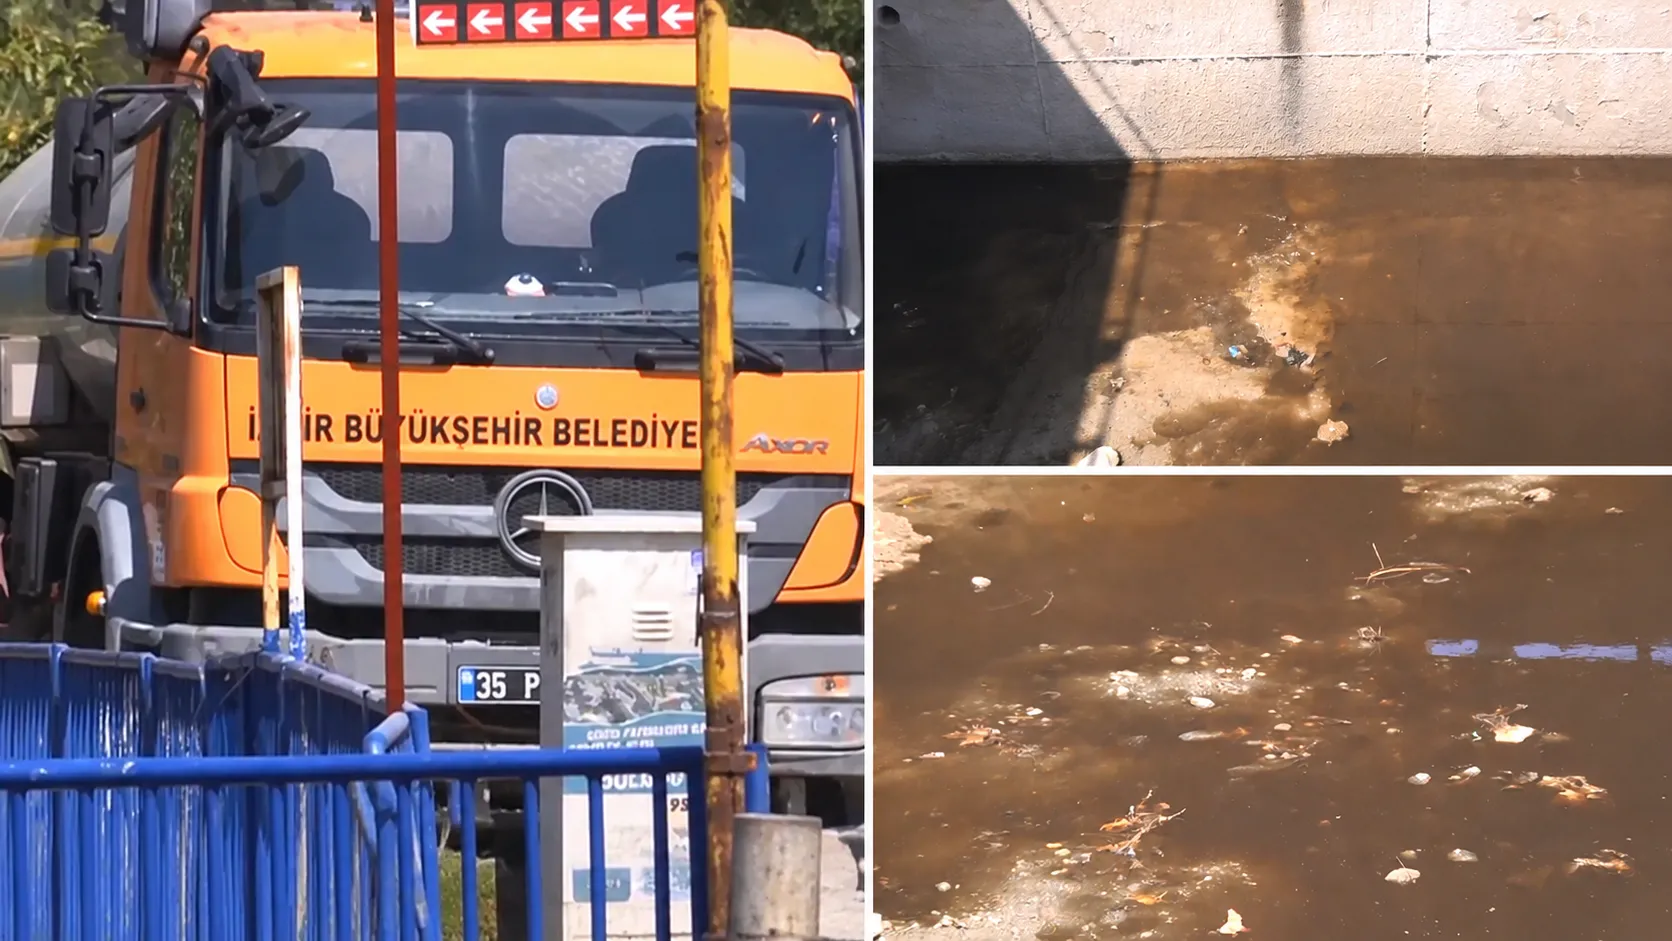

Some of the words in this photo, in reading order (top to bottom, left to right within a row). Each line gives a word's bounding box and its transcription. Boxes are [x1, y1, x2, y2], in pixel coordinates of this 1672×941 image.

[249, 406, 333, 442] İİR
[345, 408, 541, 449] BÜÜKŞEHİR
[553, 413, 698, 449] BELEDİYE
[740, 433, 829, 455] AXOR
[476, 672, 506, 699] 35
